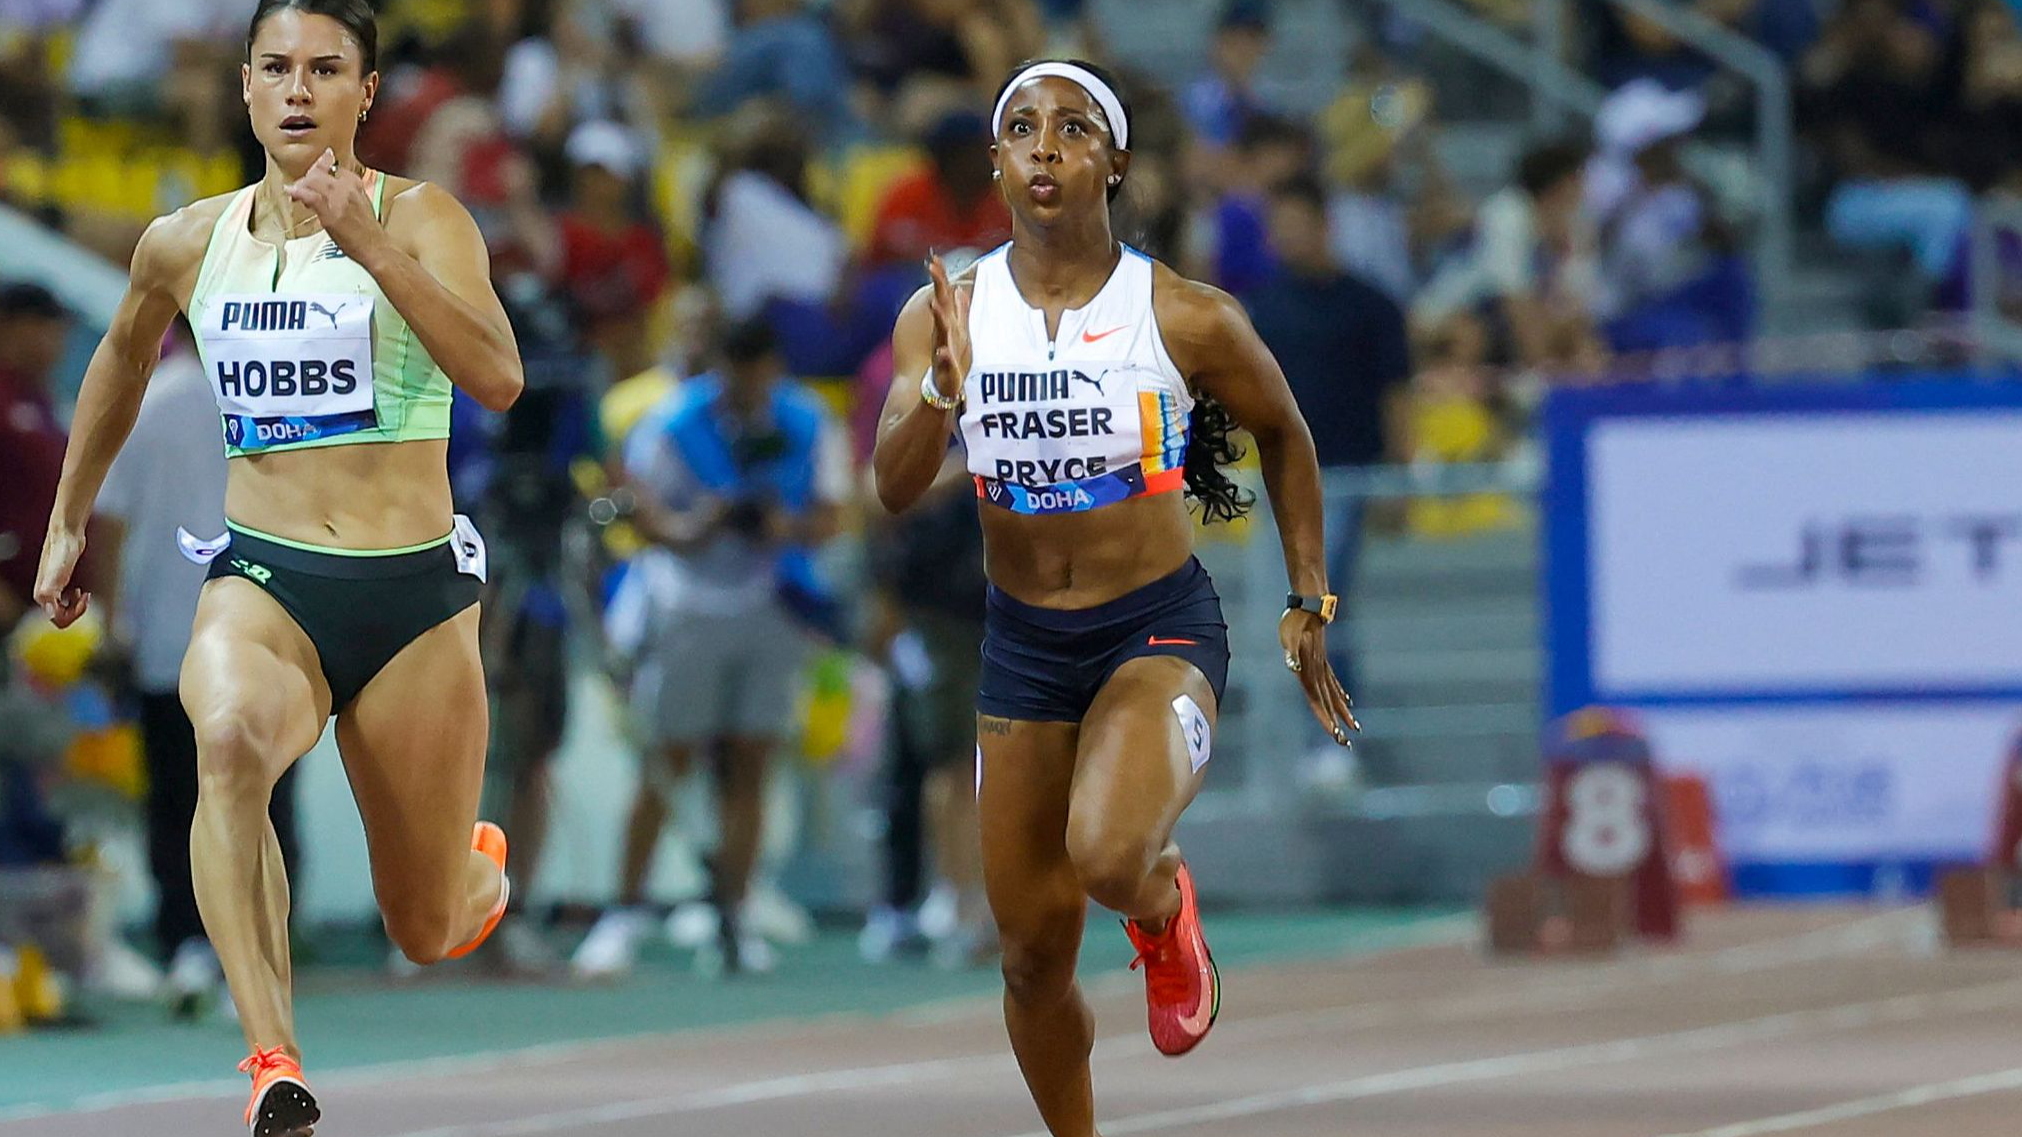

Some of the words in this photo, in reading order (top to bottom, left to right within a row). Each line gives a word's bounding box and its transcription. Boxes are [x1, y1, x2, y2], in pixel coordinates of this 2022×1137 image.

[221, 301, 307, 331] PUMA
[217, 359, 357, 397] HOBBS
[981, 369, 1069, 404] PUMA
[980, 407, 1114, 440] FRASER
[995, 456, 1107, 488] PRYCE
[1027, 488, 1091, 510] DOHA
[1193, 714, 1203, 752] 5
[1563, 761, 1651, 877] 8
